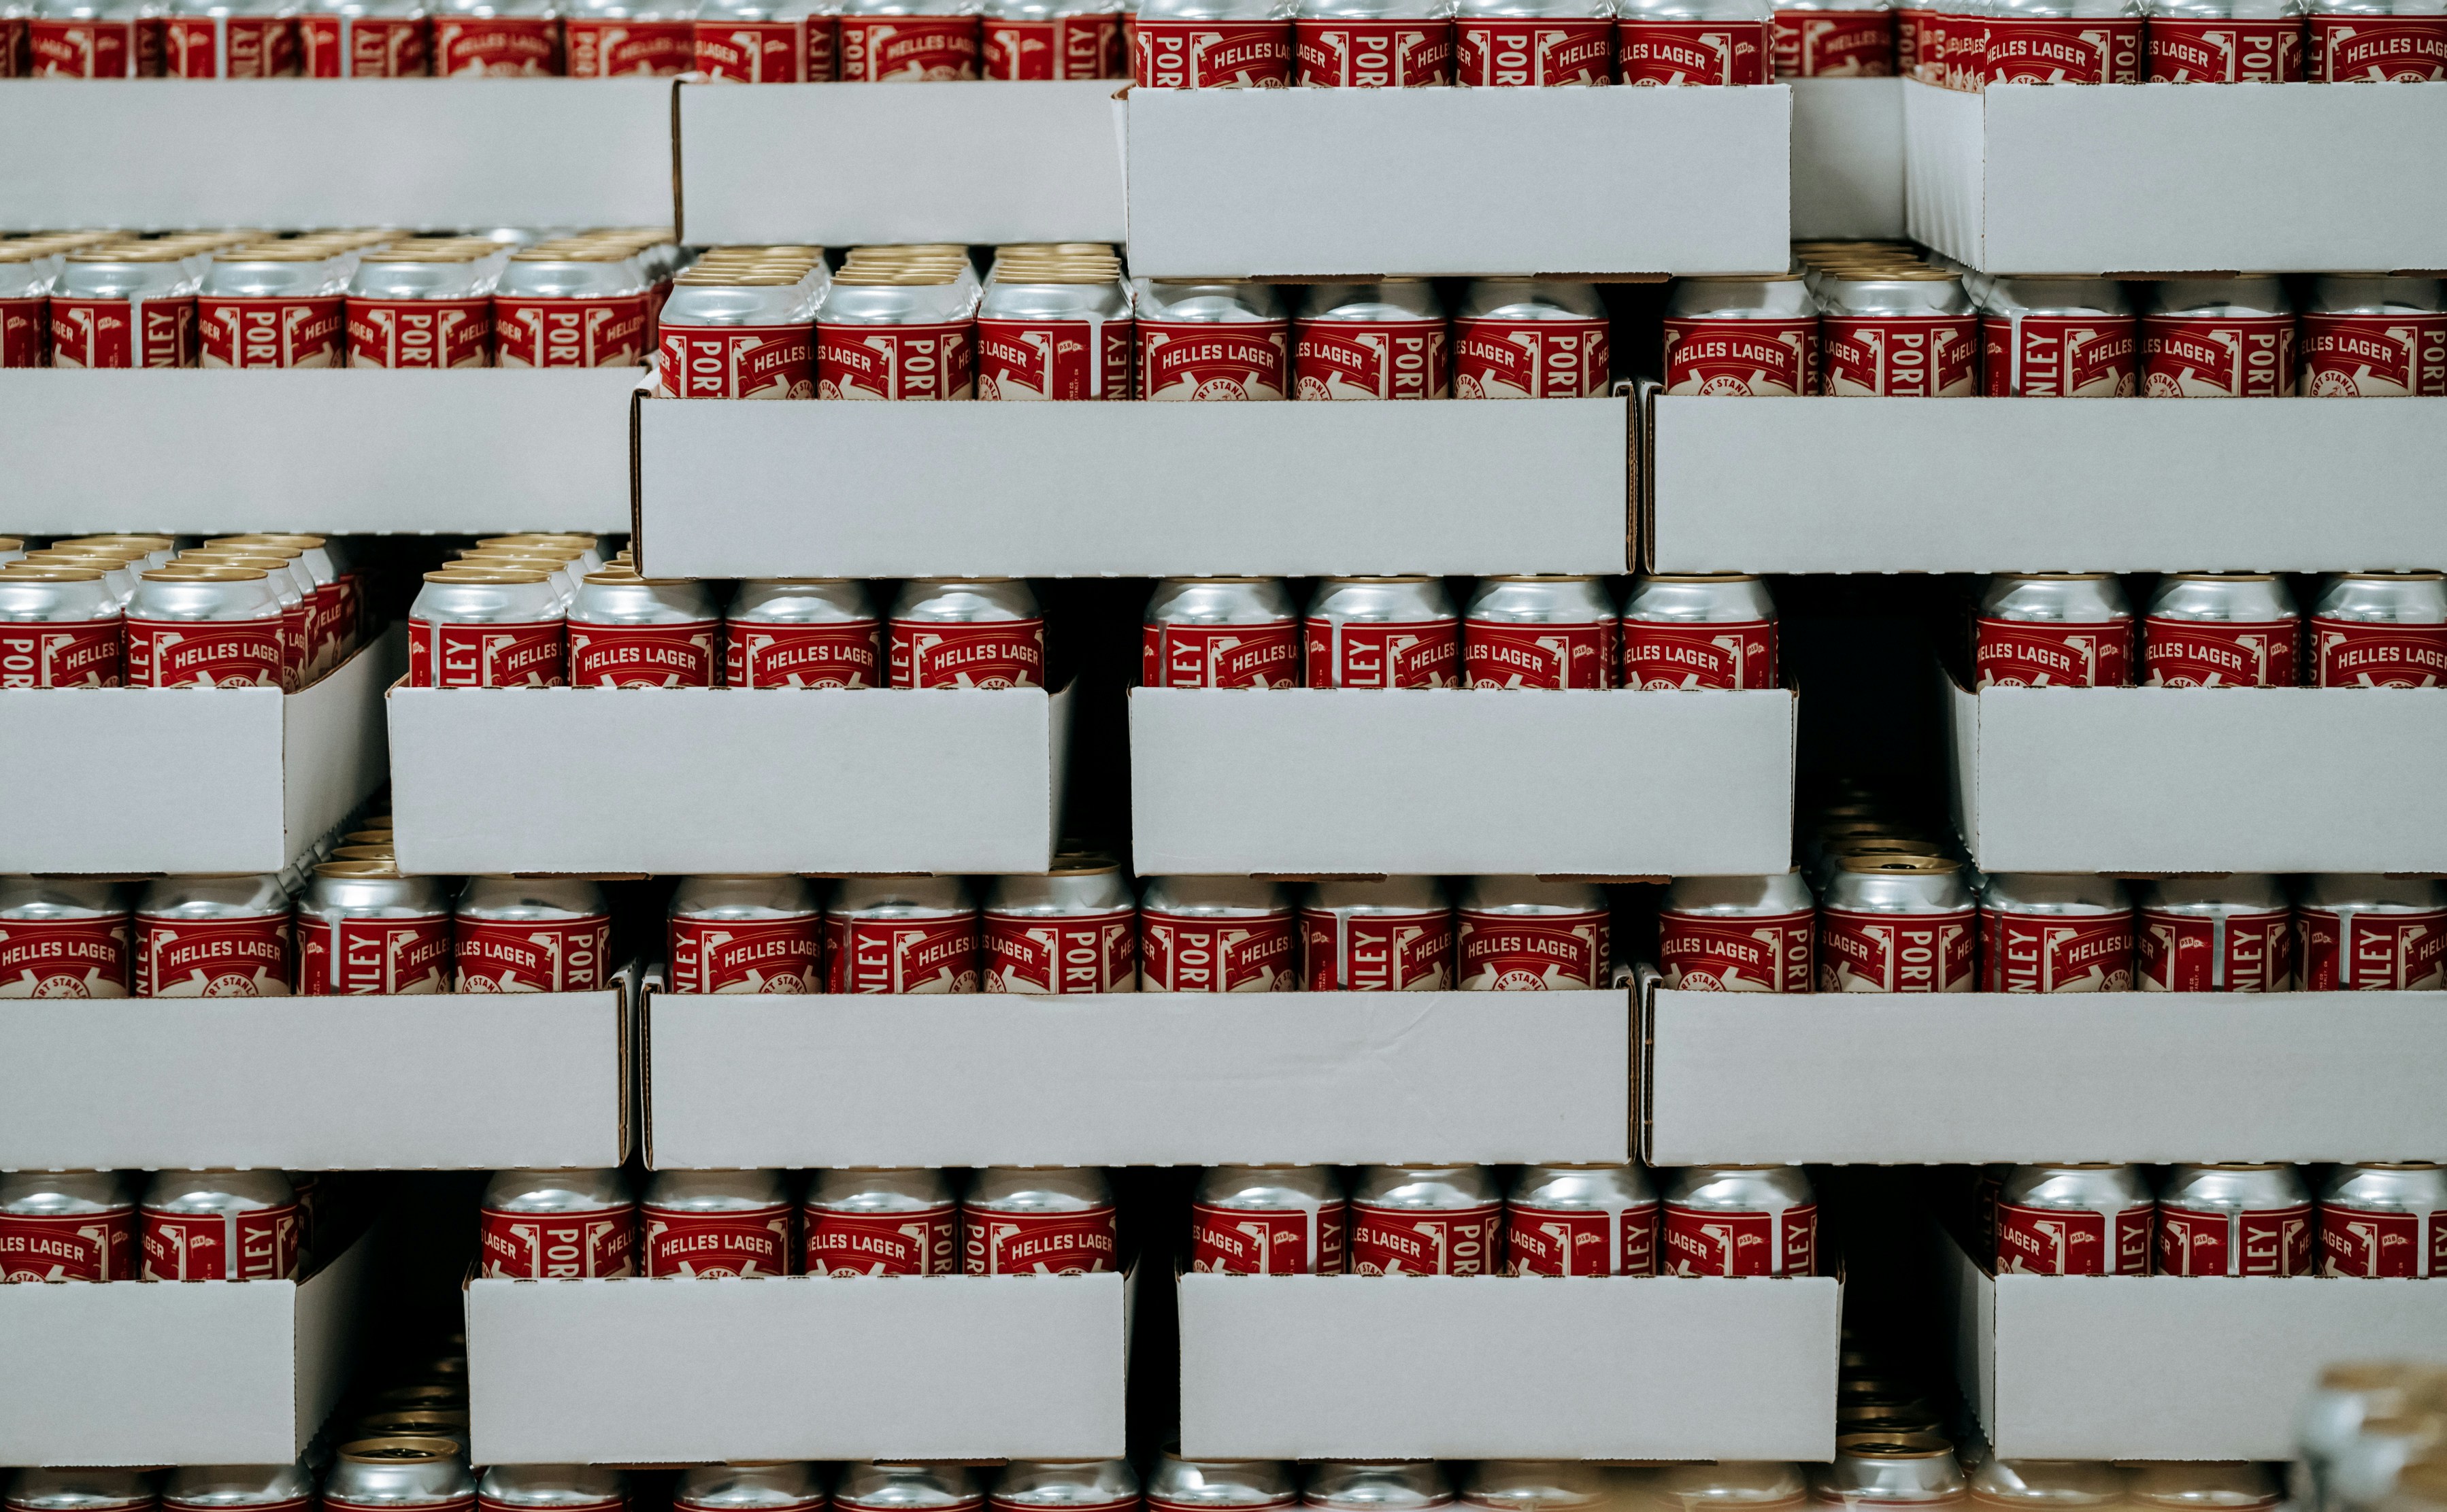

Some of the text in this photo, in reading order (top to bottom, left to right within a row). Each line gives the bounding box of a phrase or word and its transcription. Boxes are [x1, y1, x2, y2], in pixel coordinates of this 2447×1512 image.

[1214, 43, 1271, 68] HELLES
[1653, 44, 1705, 69] LAGER
[1986, 41, 2027, 65] HELLES
[2032, 40, 2086, 66] LAGER
[2163, 42, 2208, 67] LAGER
[2348, 39, 2410, 63] HELLES
[754, 346, 805, 373] HELLES
[829, 347, 871, 372] LAGER
[986, 343, 1027, 367] LAGER
[1163, 344, 1274, 369] HELLES LAGER
[1314, 343, 1362, 369] LAGER
[1469, 341, 1514, 367] LAGER
[1675, 342, 1784, 369] HELLES LAGER
[1825, 340, 1859, 365] LAGER
[2089, 340, 2132, 365] HELLES
[2165, 340, 2215, 366] LAGER
[2339, 337, 2392, 363] LAGER
[67, 642, 114, 671] HELLES
[176, 643, 279, 669] HELLES LAGER
[508, 642, 556, 671] HELLES
[585, 647, 696, 672] HELLES LAGER
[767, 645, 873, 671] HELLES LAGER
[935, 643, 1038, 670] HELLES LAGER
[1233, 644, 1285, 673] HELLES
[1412, 643, 1454, 671] HELLES
[1492, 648, 1542, 673] LAGER
[1665, 645, 1718, 671] LAGER
[2018, 644, 2070, 672] LAGER
[2188, 644, 2241, 671] LAGER
[2339, 646, 2399, 669] HELLES
[3, 941, 116, 967] HELLES LAGER
[171, 940, 280, 967] HELLES LAGER
[485, 943, 535, 969] LAGER
[725, 940, 785, 967] HELLES
[919, 937, 969, 967] HELLES
[992, 940, 1033, 964] LAGER
[1242, 939, 1288, 965] HELLES
[1469, 937, 1577, 961] HELLES LAGER
[1706, 940, 1759, 964] LAGER
[2069, 936, 2121, 964] HELLES
[31, 1237, 84, 1262] LAGER
[484, 1232, 516, 1260] LAGER
[662, 1234, 773, 1258] HELLES LAGER
[852, 1236, 905, 1260] LAGER
[1012, 1234, 1112, 1260] HELLES LAGER
[1202, 1230, 1243, 1258] LAGER
[1373, 1230, 1420, 1258] LAGER
[1510, 1227, 1546, 1258] LAGER
[1669, 1231, 1707, 1260] LAGER
[2003, 1226, 2039, 1256] LAGER
